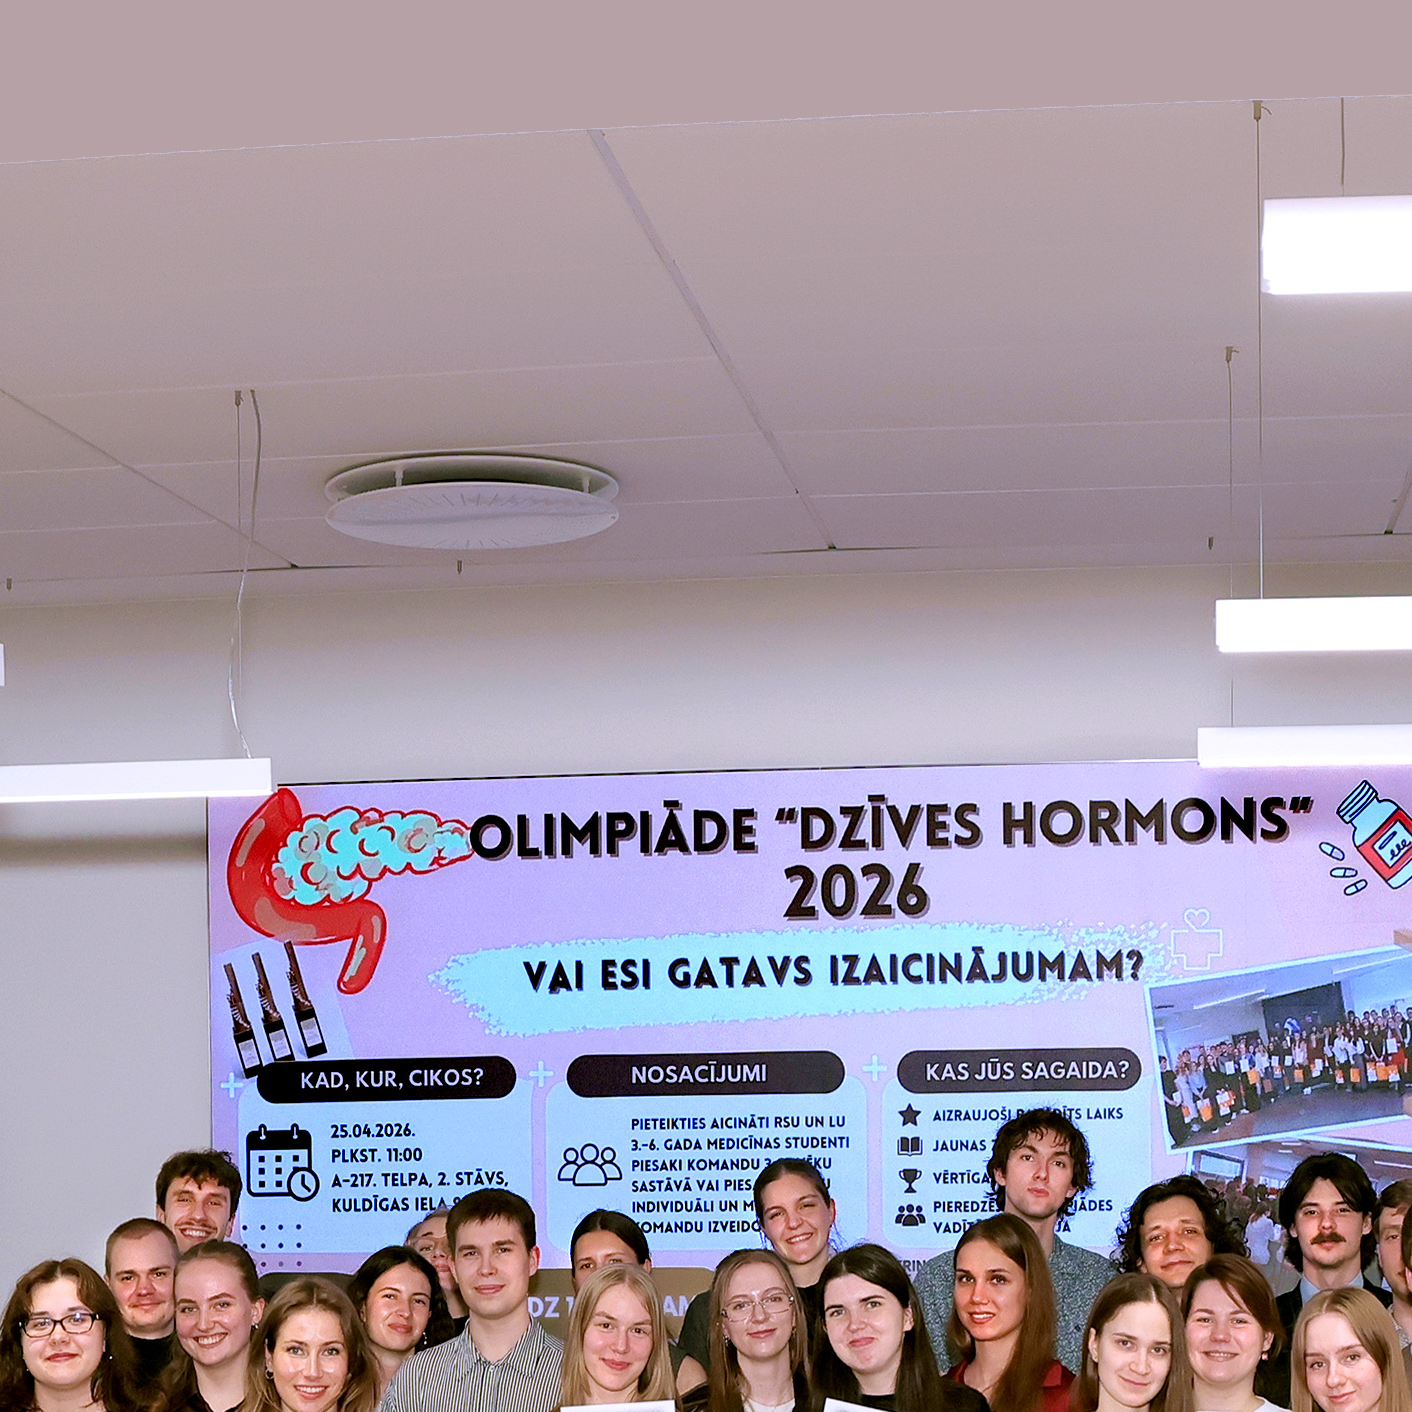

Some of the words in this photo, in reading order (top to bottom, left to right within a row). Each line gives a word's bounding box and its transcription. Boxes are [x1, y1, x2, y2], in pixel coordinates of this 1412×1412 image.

[470, 800, 758, 859] OLIMPIĀDE
[783, 862, 929, 920] 2026
[523, 959, 584, 994] VAI
[601, 958, 650, 990] ESI
[668, 955, 812, 989] GATAVS
[830, 946, 1145, 986] IZAICINĀJUMAM?
[631, 1062, 767, 1084] NOSACĪJUMI
[926, 1063, 970, 1081] KAS
[974, 1058, 1015, 1080] JŪS
[1021, 1061, 1130, 1080] SAGAIDA?
[301, 1072, 349, 1091] KAD,
[356, 1070, 403, 1090] KUR,
[409, 1069, 484, 1087] CIKOS?
[933, 1106, 1011, 1121] AIZRAUJOŠI
[1086, 1107, 1123, 1120] LAIKS
[331, 1123, 416, 1139] 25.04.2026.
[631, 1117, 706, 1131] PIETEIKTIES
[710, 1114, 769, 1129] AICINĀTI
[774, 1116, 800, 1128] RSU
[805, 1116, 825, 1128] UN
[829, 1115, 846, 1127] LU
[664, 1138, 702, 1151] GADA
[707, 1134, 781, 1150] MEDICĪNAS
[785, 1136, 850, 1149] STUDENTI
[932, 1139, 987, 1152] JAUNAS
[331, 1148, 381, 1163] PLKST.
[387, 1147, 423, 1162] 11:00
[631, 1159, 683, 1172] PIESAKI
[687, 1158, 760, 1171] KOMANDU
[381, 1171, 433, 1188] TELPA,
[438, 1172, 450, 1186] 2.
[455, 1168, 509, 1187] STĀVS,
[631, 1177, 691, 1193] SASTĀVĀ
[698, 1179, 719, 1192] VAI
[332, 1195, 409, 1213] KULDĪGAS
[632, 1198, 714, 1213] INDIVIDUĀLI
[719, 1200, 738, 1212] UN
[638, 1221, 703, 1233] OMANDU
